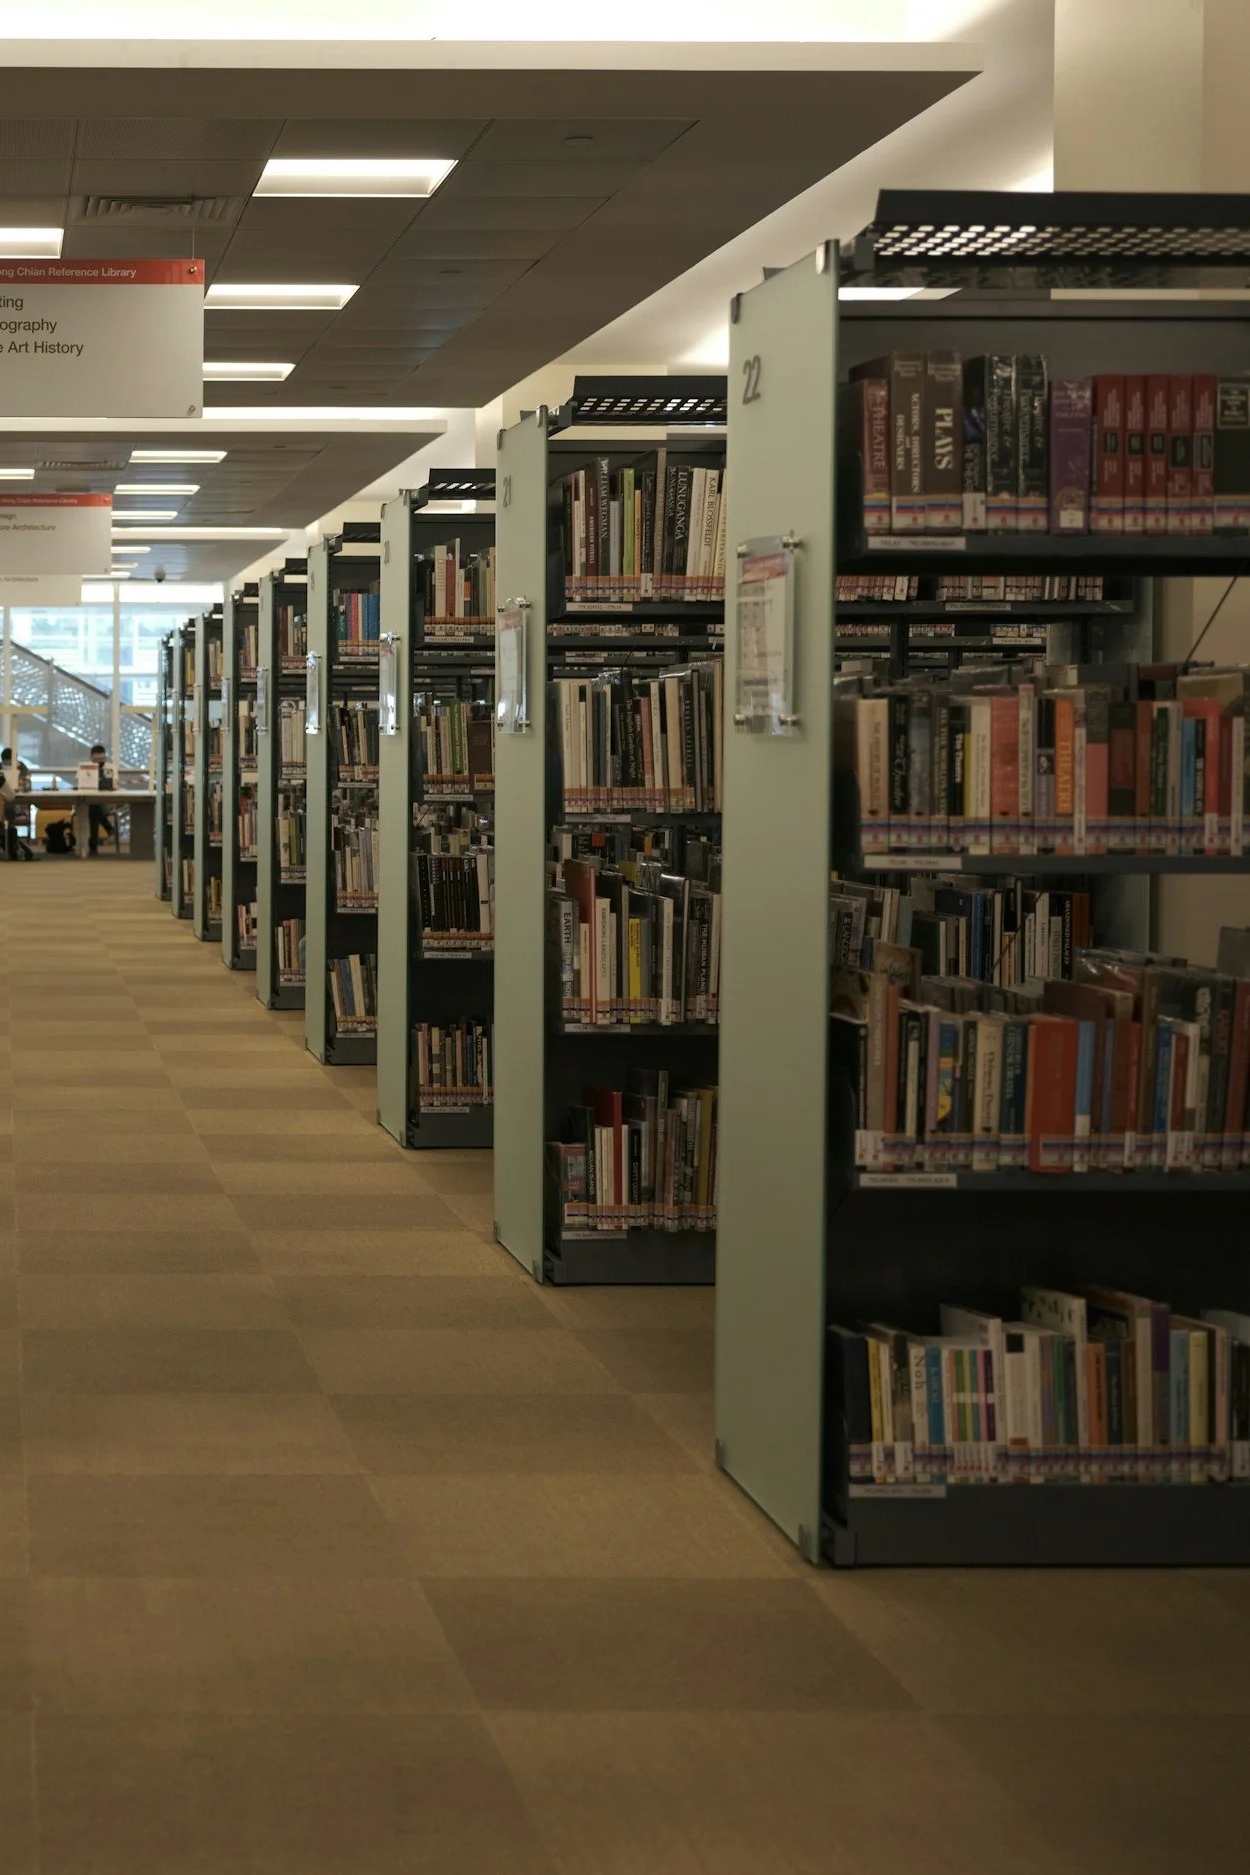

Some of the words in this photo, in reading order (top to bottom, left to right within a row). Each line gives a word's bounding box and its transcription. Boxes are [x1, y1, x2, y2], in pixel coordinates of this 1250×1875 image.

[17, 267, 46, 277] Chian
[48, 267, 99, 277] Reference
[101, 267, 137, 279] Library
[8, 341, 29, 354] Art
[34, 341, 84, 356] History
[742, 355, 761, 405] 22
[910, 393, 920, 433] ACTORS,
[872, 404, 886, 469] THEATRE
[896, 414, 904, 470] DESIGNERS
[934, 408, 953, 470] PLAYS
[600, 459, 608, 497] WILLIAM
[910, 436, 920, 493] DIRECTORS
[675, 472, 688, 540] LUNUGANGA
[706, 478, 717, 499] KARL
[600, 498, 608, 538] WEGMAN
[703, 501, 715, 547] BLOSSFELDT
[626, 712, 634, 733] English
[954, 733, 962, 750] The
[629, 763, 637, 778] Night
[954, 751, 962, 784] Theatre
[1057, 740, 1071, 812] THEATRE
[564, 912, 572, 944] EARTH
[840, 924, 851, 963] LANDSCA
